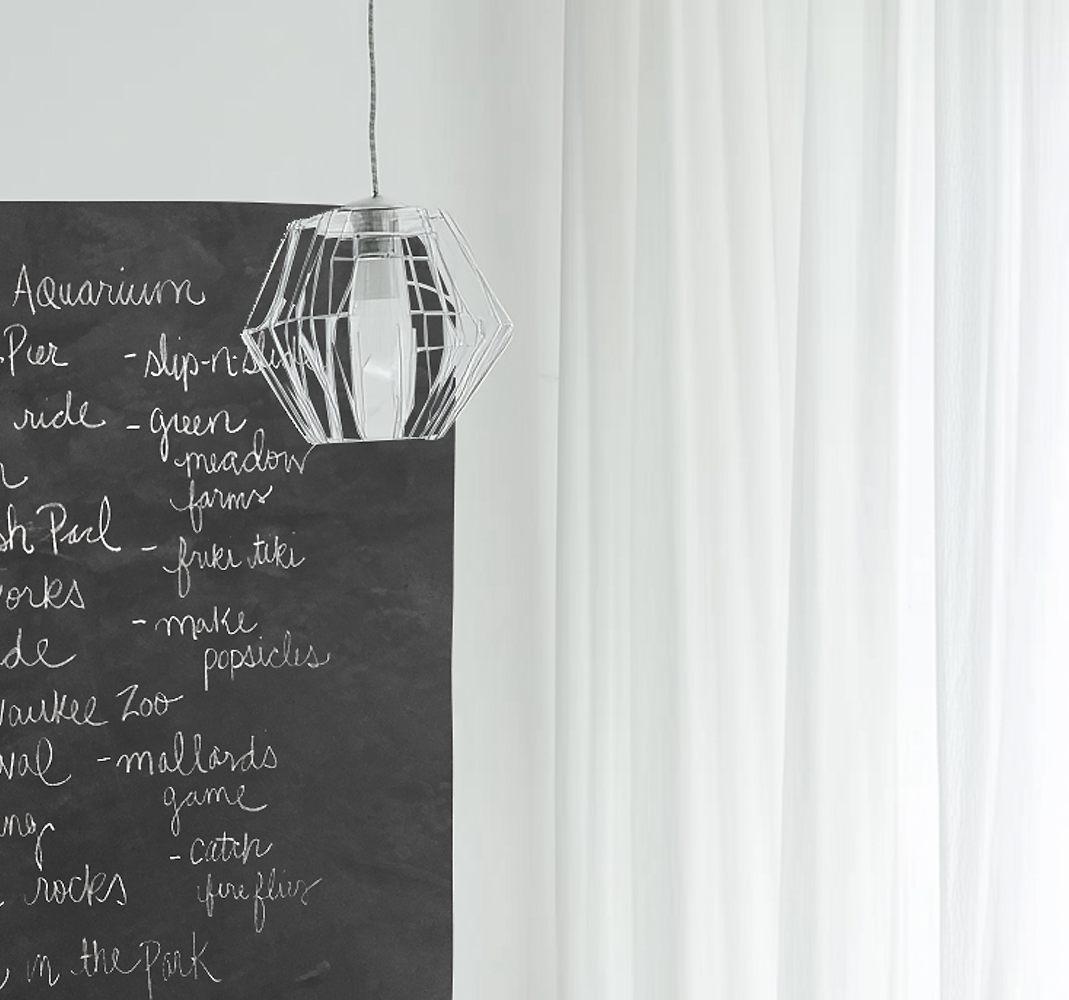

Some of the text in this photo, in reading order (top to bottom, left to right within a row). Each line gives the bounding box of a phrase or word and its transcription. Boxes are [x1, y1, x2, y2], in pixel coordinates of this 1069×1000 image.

[12, 263, 206, 316] Aquarium
[3, 322, 69, 377] Pier
[13, 390, 107, 431] ride
[149, 407, 247, 462] green
[174, 428, 315, 478] meadow
[169, 479, 273, 533] farms
[246, 531, 306, 570] tiki
[154, 606, 258, 641] make
[205, 630, 331, 691] popsicles
[116, 683, 184, 722] Zoo
[115, 730, 278, 777] mallards
[163, 784, 268, 837] game
[190, 831, 273, 865] catch
[24, 864, 127, 906] rocks
[26, 952, 61, 987] in
[70, 937, 142, 978] the
